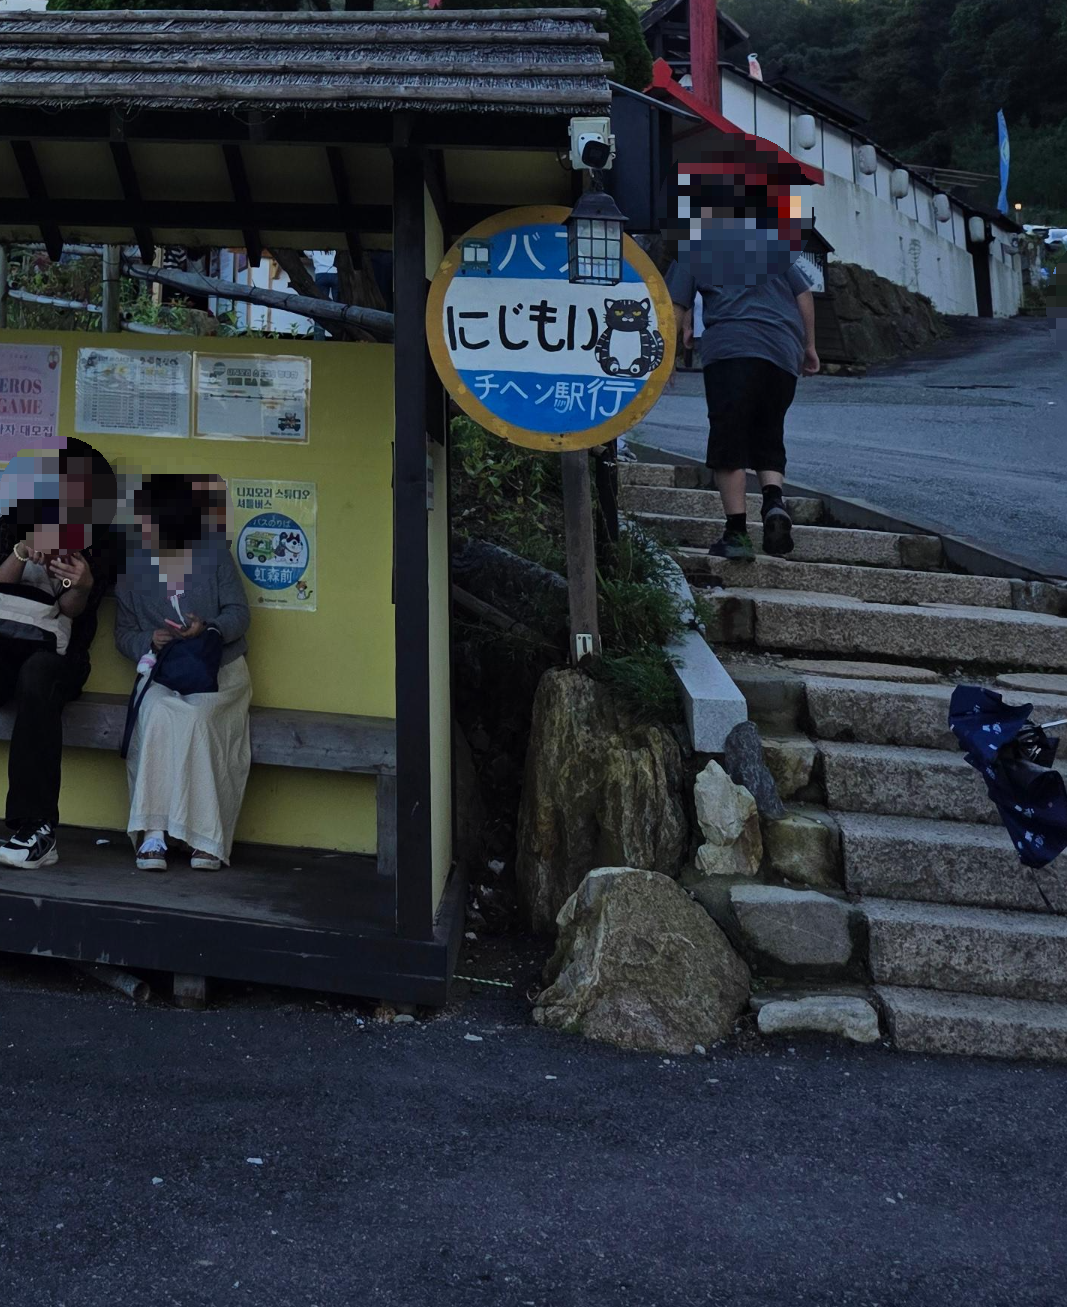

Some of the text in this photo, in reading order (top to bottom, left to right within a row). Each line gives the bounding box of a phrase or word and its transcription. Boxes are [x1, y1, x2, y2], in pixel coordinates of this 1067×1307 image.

[446, 299, 599, 353] にじもり
[20, 424, 54, 438] 대모집
[236, 487, 311, 501] 니지모리 스튜디오
[236, 498, 273, 510] 셔틀버스
[252, 517, 292, 528] バスのりば
[253, 566, 293, 584] 虹森前
